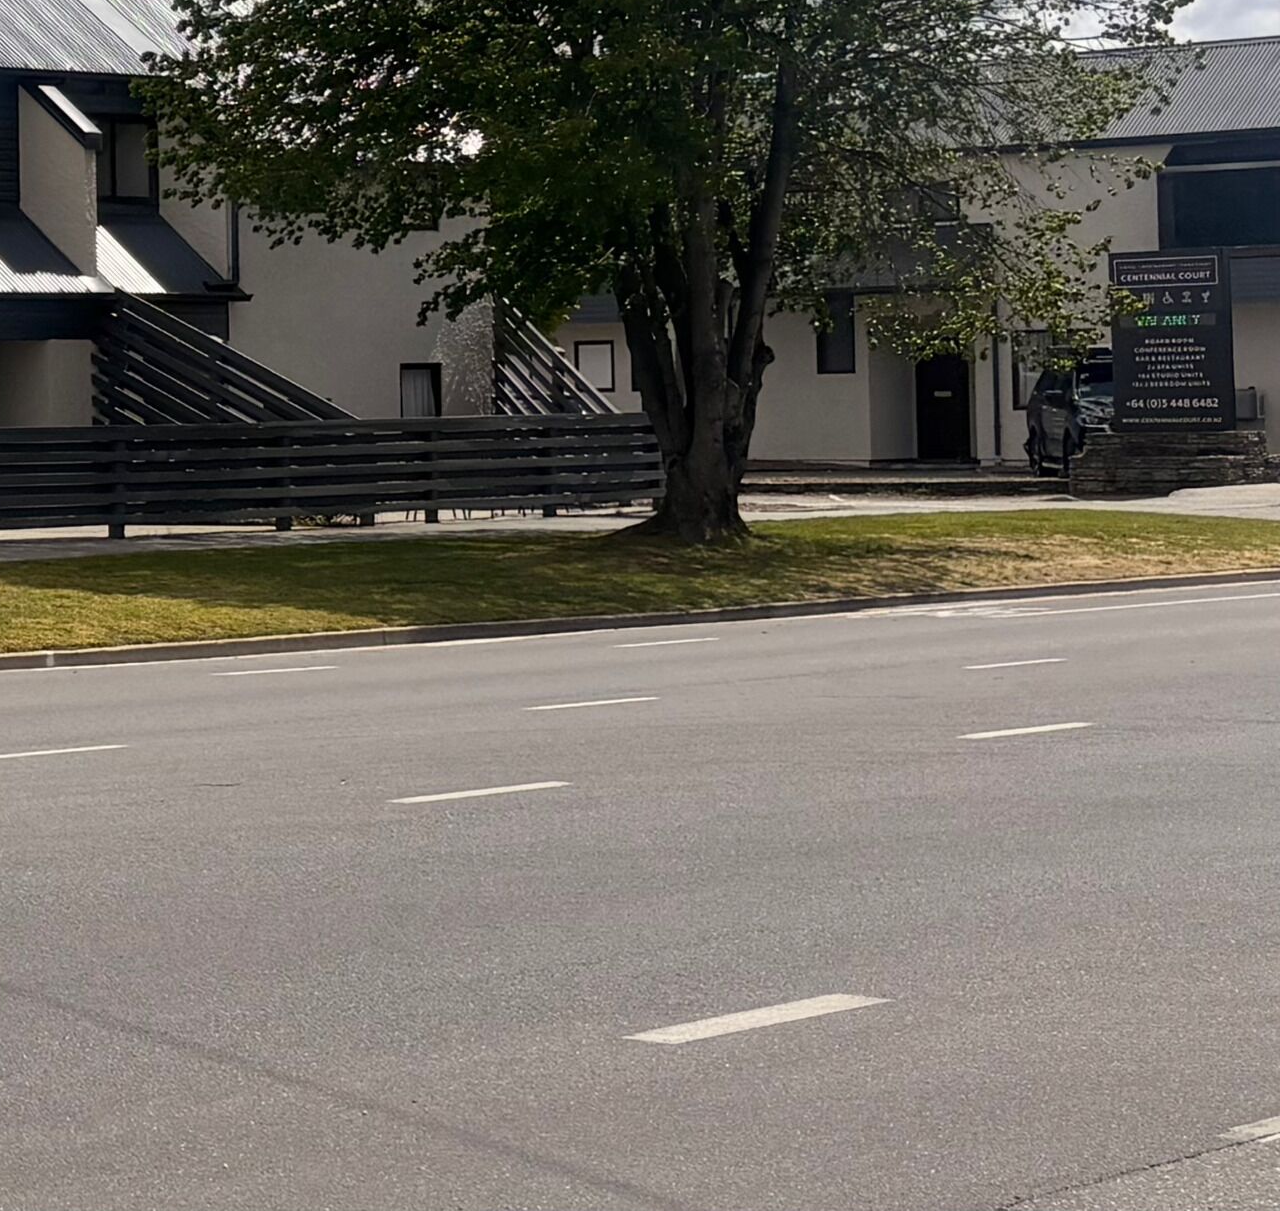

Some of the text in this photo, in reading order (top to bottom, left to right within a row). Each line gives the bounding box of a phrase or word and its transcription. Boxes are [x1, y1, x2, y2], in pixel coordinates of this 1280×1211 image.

[1120, 271, 1211, 282] CENTENNIAL COURT
[1126, 399, 1144, 408] +64
[1169, 398, 1190, 407] 448
[1192, 398, 1219, 407] 6482
